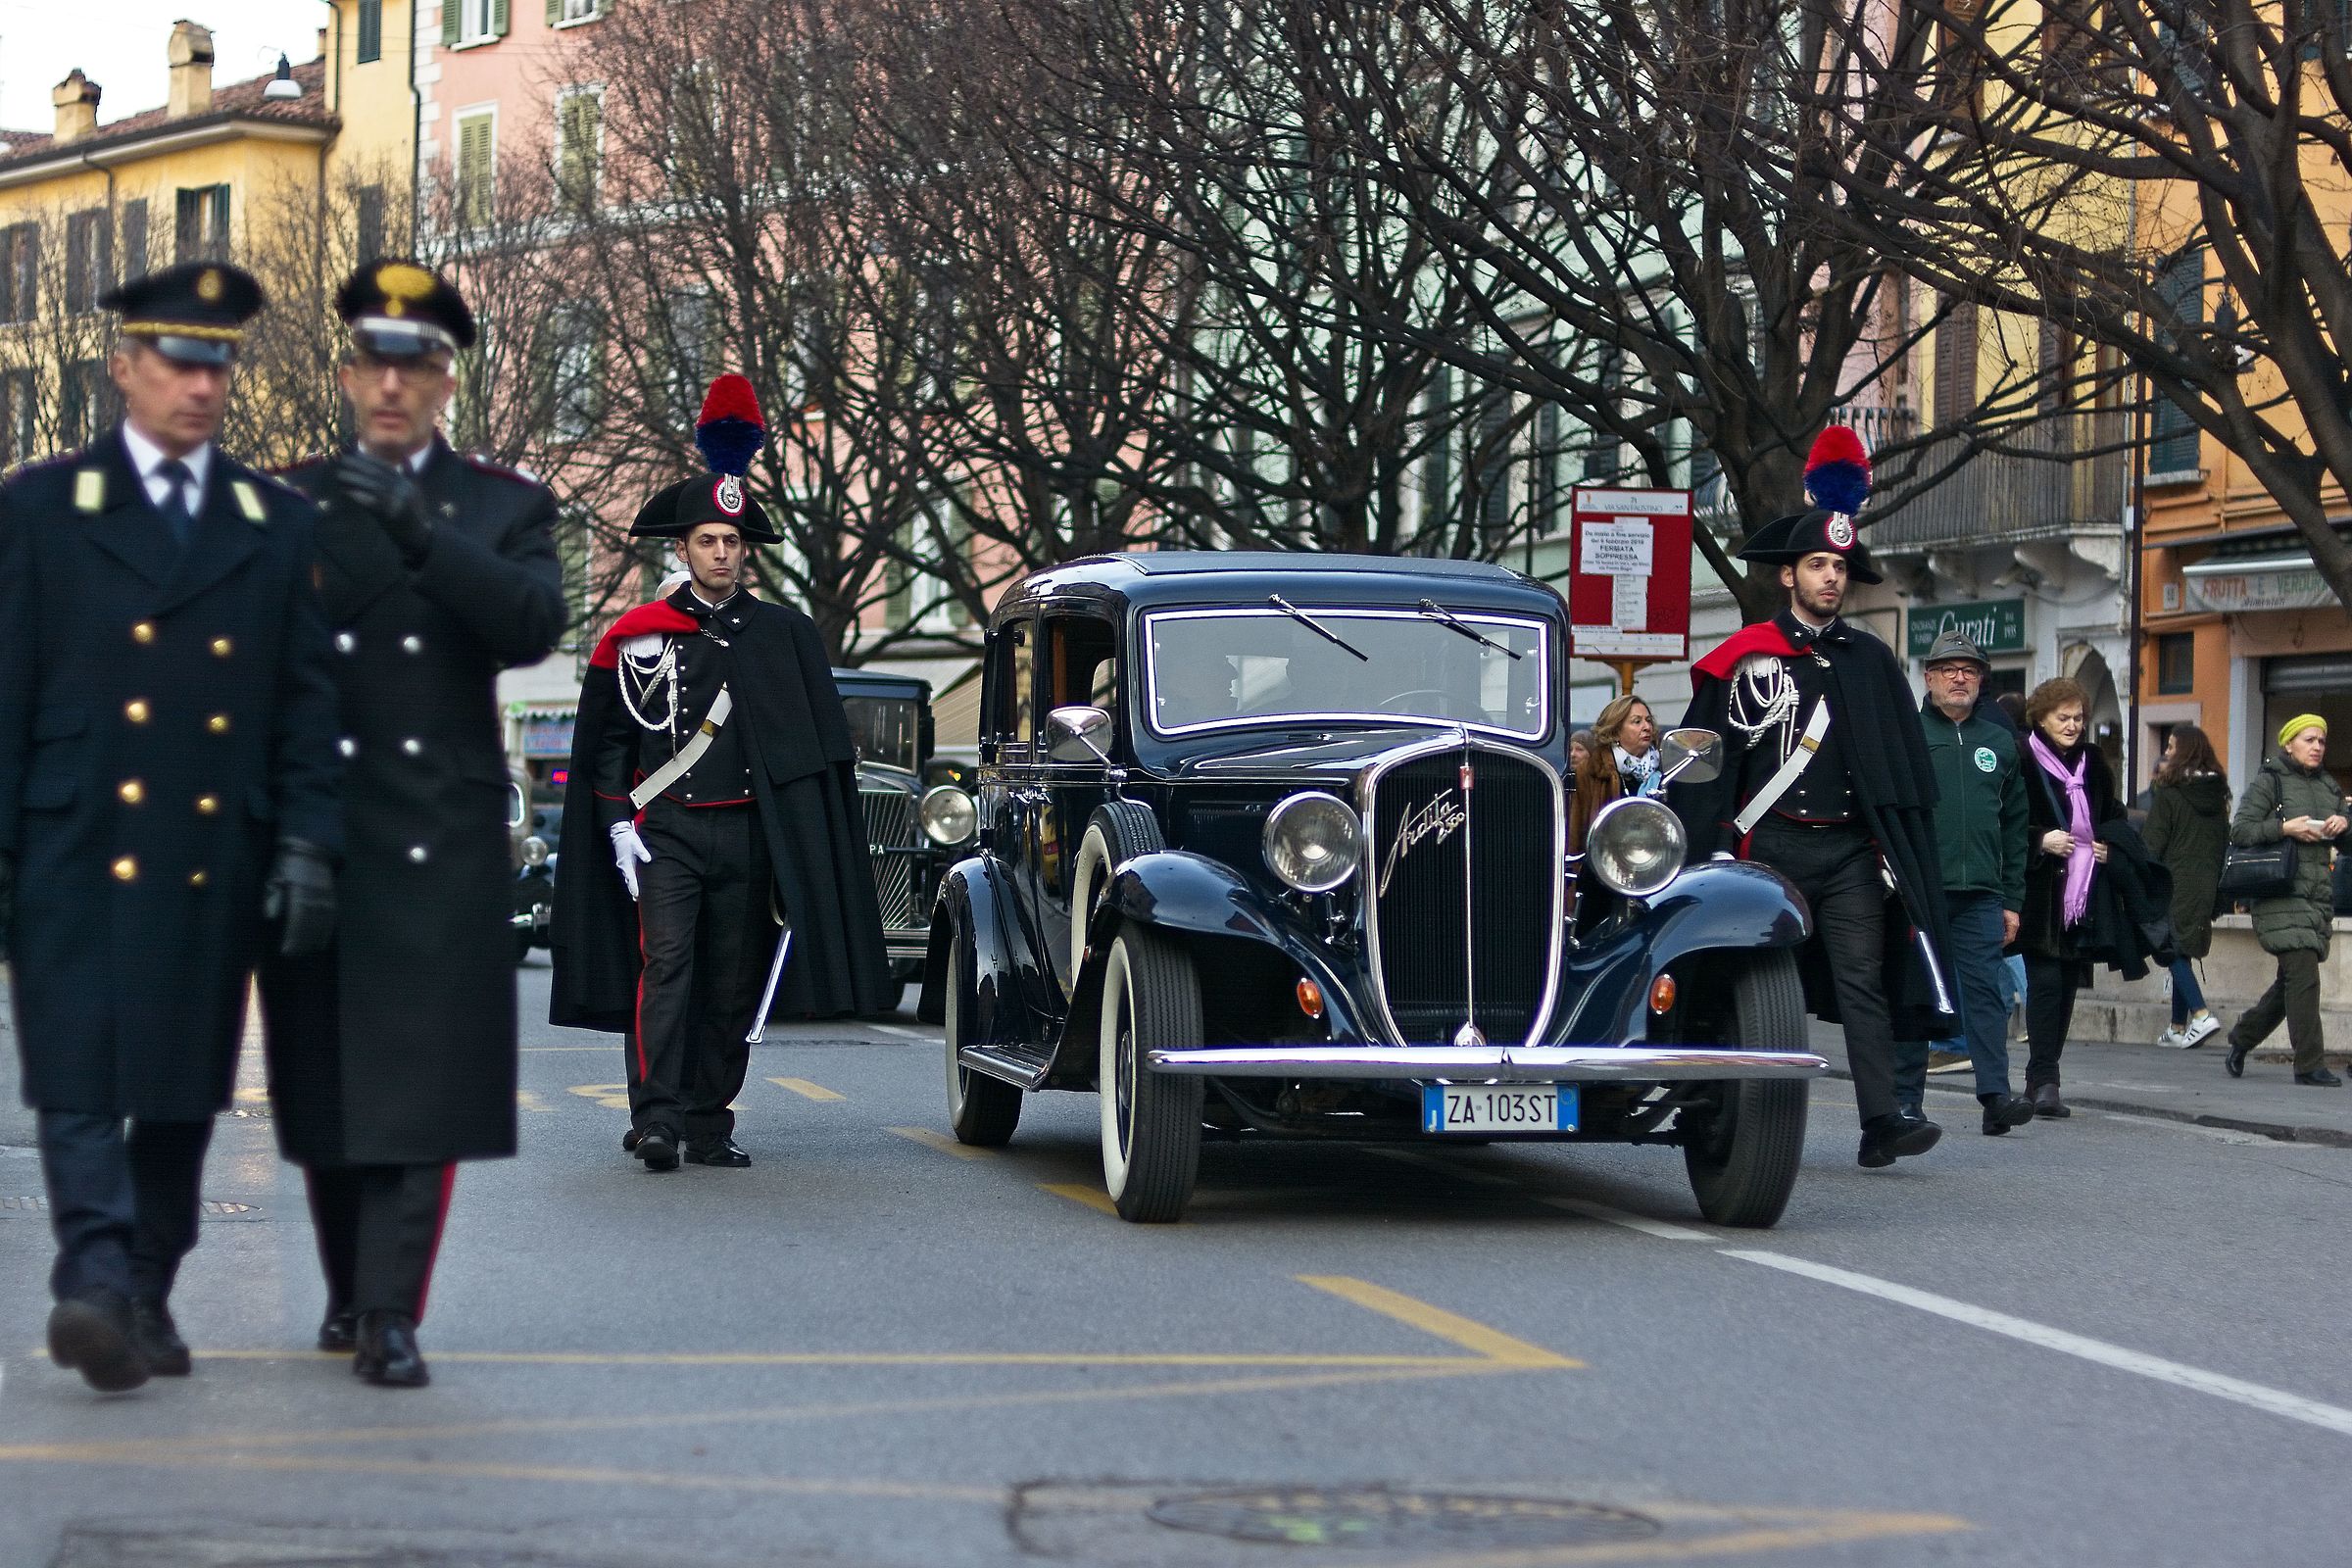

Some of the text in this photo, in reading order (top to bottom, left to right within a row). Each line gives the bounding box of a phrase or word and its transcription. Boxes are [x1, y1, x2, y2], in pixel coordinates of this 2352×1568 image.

[2203, 576, 2247, 598] FRUTTA
[2257, 575, 2266, 596] E
[1939, 606, 1997, 646] Curati
[1379, 788, 1459, 898] Ardita
[1437, 812, 1465, 844] 2500
[1447, 1094, 1557, 1124] ZA 103ST
